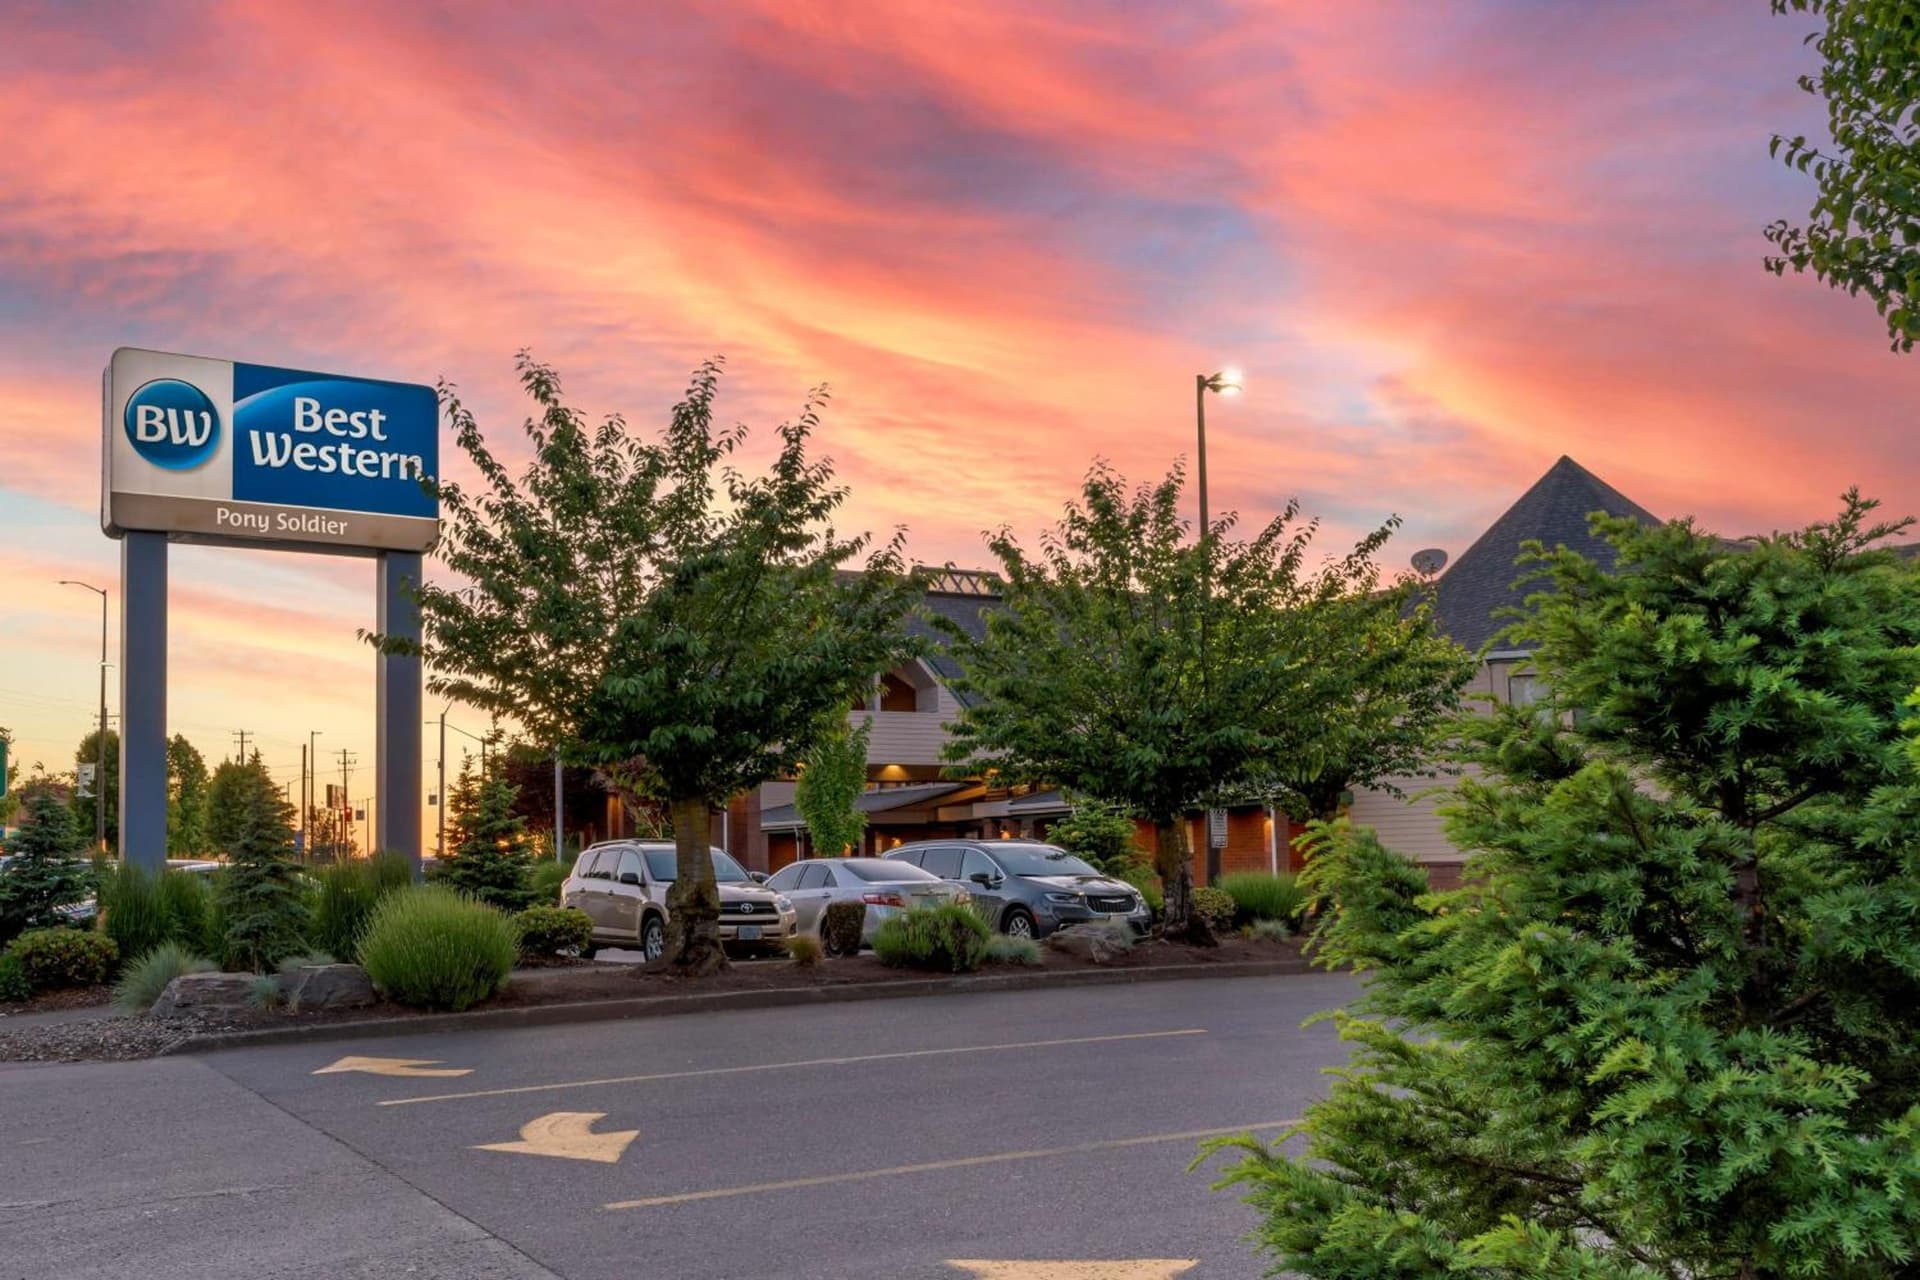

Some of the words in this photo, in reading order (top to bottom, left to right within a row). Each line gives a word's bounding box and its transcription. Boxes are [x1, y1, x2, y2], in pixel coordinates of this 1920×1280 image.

[136, 405, 212, 447] BW
[294, 397, 387, 441] Best
[250, 430, 424, 481] Western
[216, 507, 270, 532] Pony
[277, 512, 348, 535] Soldier
